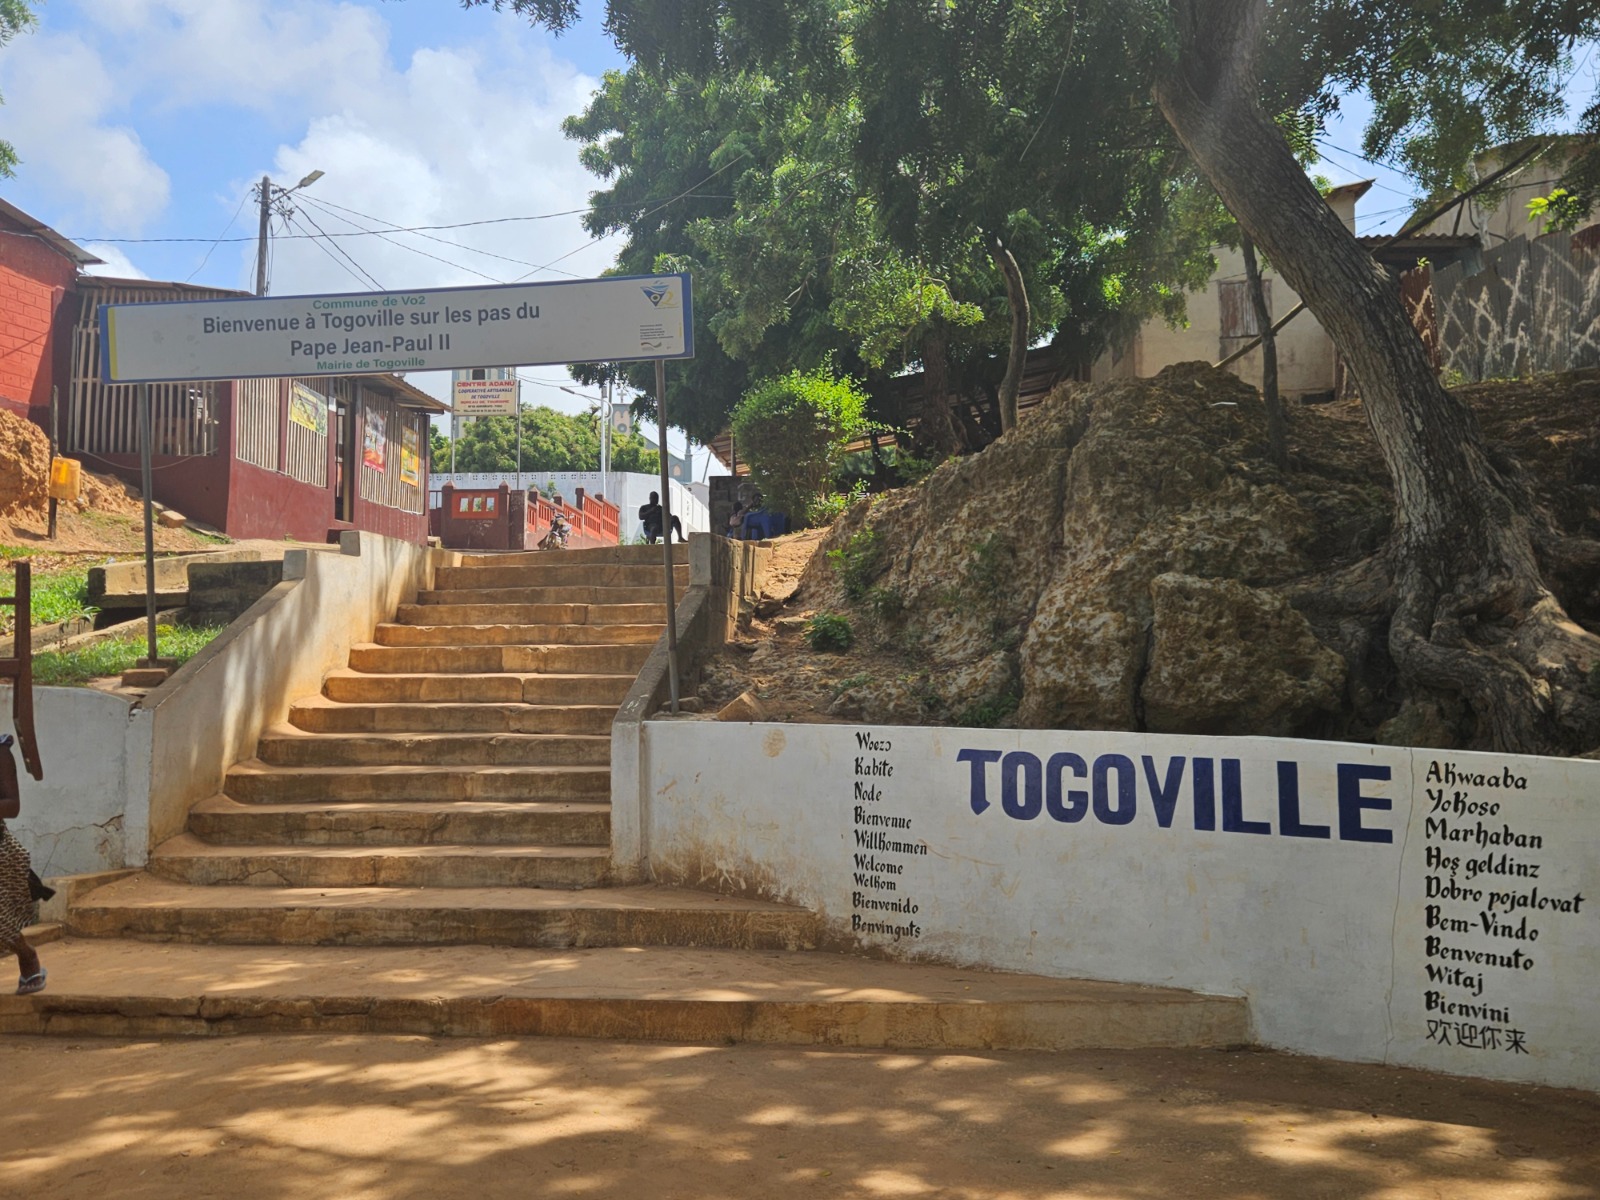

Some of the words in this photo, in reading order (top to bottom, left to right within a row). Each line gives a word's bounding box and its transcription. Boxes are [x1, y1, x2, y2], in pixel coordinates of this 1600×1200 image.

[313, 299, 378, 310] Commune
[382, 296, 398, 307] de
[401, 295, 426, 306] Vo2
[203, 315, 300, 334] Bienvenue
[305, 312, 316, 330] à
[321, 309, 405, 332] Togoville
[410, 307, 439, 326] sur
[445, 305, 472, 323] les
[477, 306, 511, 325] pas
[516, 301, 540, 320] du
[291, 340, 337, 359] Pape
[342, 335, 433, 355] Jean-Paul
[438, 334, 450, 350] II
[317, 360, 353, 370] Mairie
[356, 359, 370, 369] de
[373, 357, 426, 369] Togoville
[854, 756, 894, 777] Kabite
[854, 781, 882, 802] Node
[956, 748, 1393, 844] TOGOVILLE
[853, 805, 912, 830] Bienvenue
[1425, 816, 1543, 851] Marhaban
[853, 852, 904, 875] Welcome
[1465, 851, 1541, 880] geldinz
[852, 890, 919, 915] Bienvenido
[1424, 875, 1483, 903] Dobro
[1487, 886, 1586, 914] pojalovat
[851, 913, 921, 942] Benvinguts
[1424, 904, 1540, 942] Bem-Vindo
[1424, 935, 1534, 971] Benvenuto
[1424, 963, 1483, 997] Witaj
[1423, 990, 1511, 1024] Bienvini
[1425, 1018, 1530, 1055] 欢迎你来
